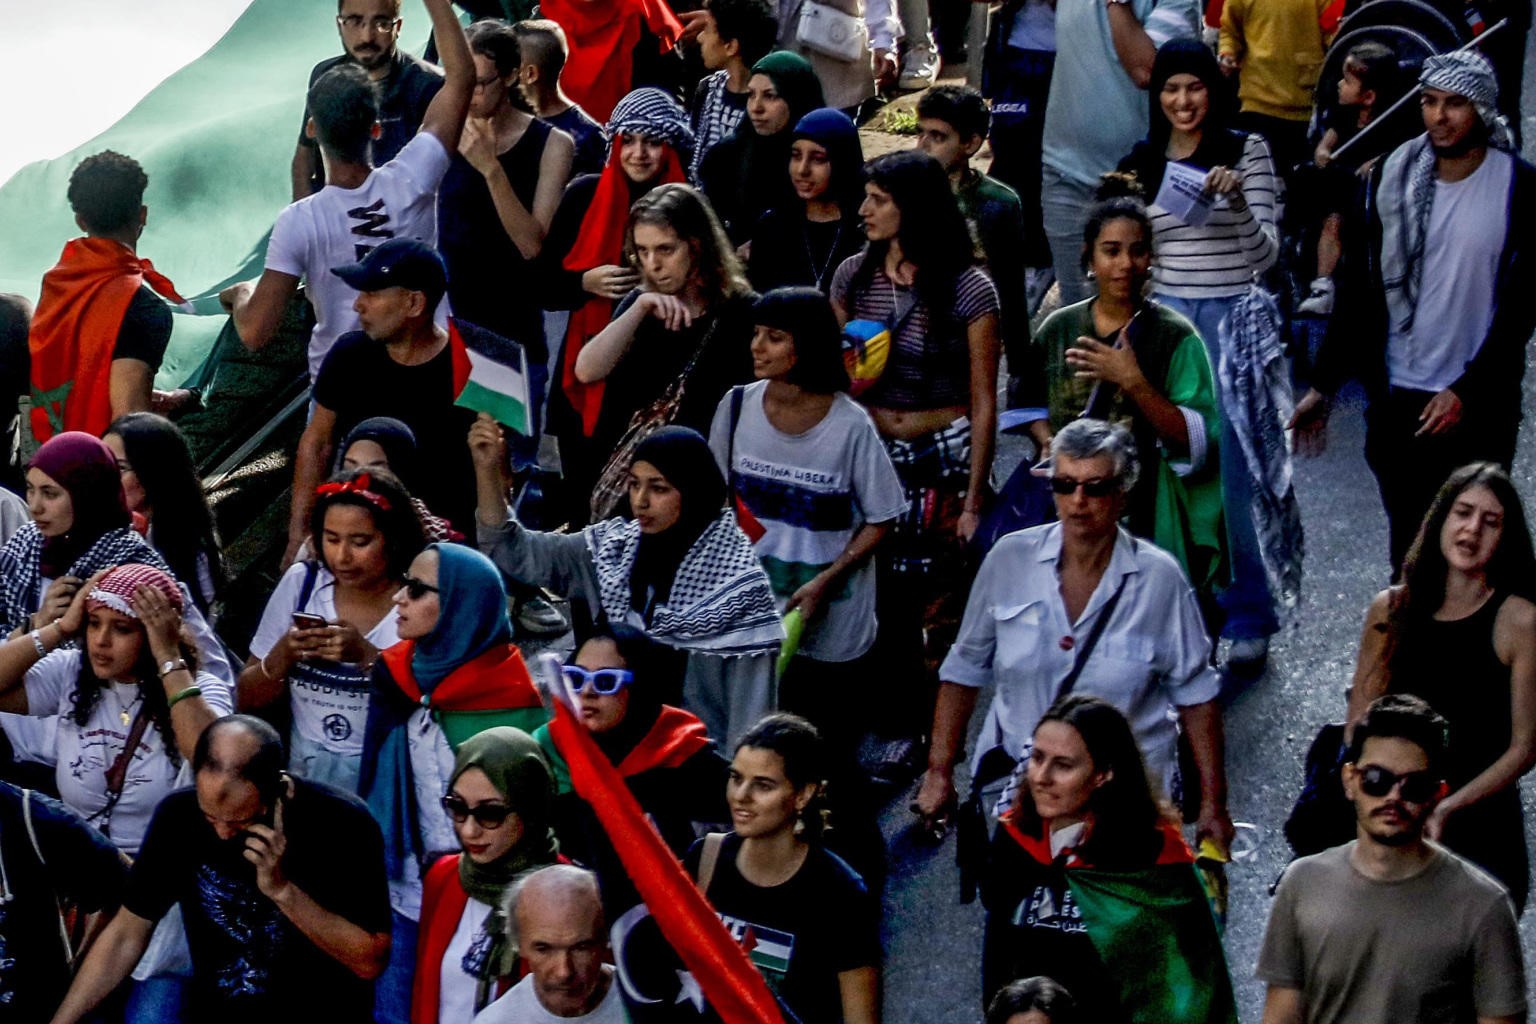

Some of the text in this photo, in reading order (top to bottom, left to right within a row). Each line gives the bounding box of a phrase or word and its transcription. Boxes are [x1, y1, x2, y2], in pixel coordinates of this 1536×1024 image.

[741, 457, 835, 485] PALESTINA LIBERA
[1034, 885, 1073, 902] FE
